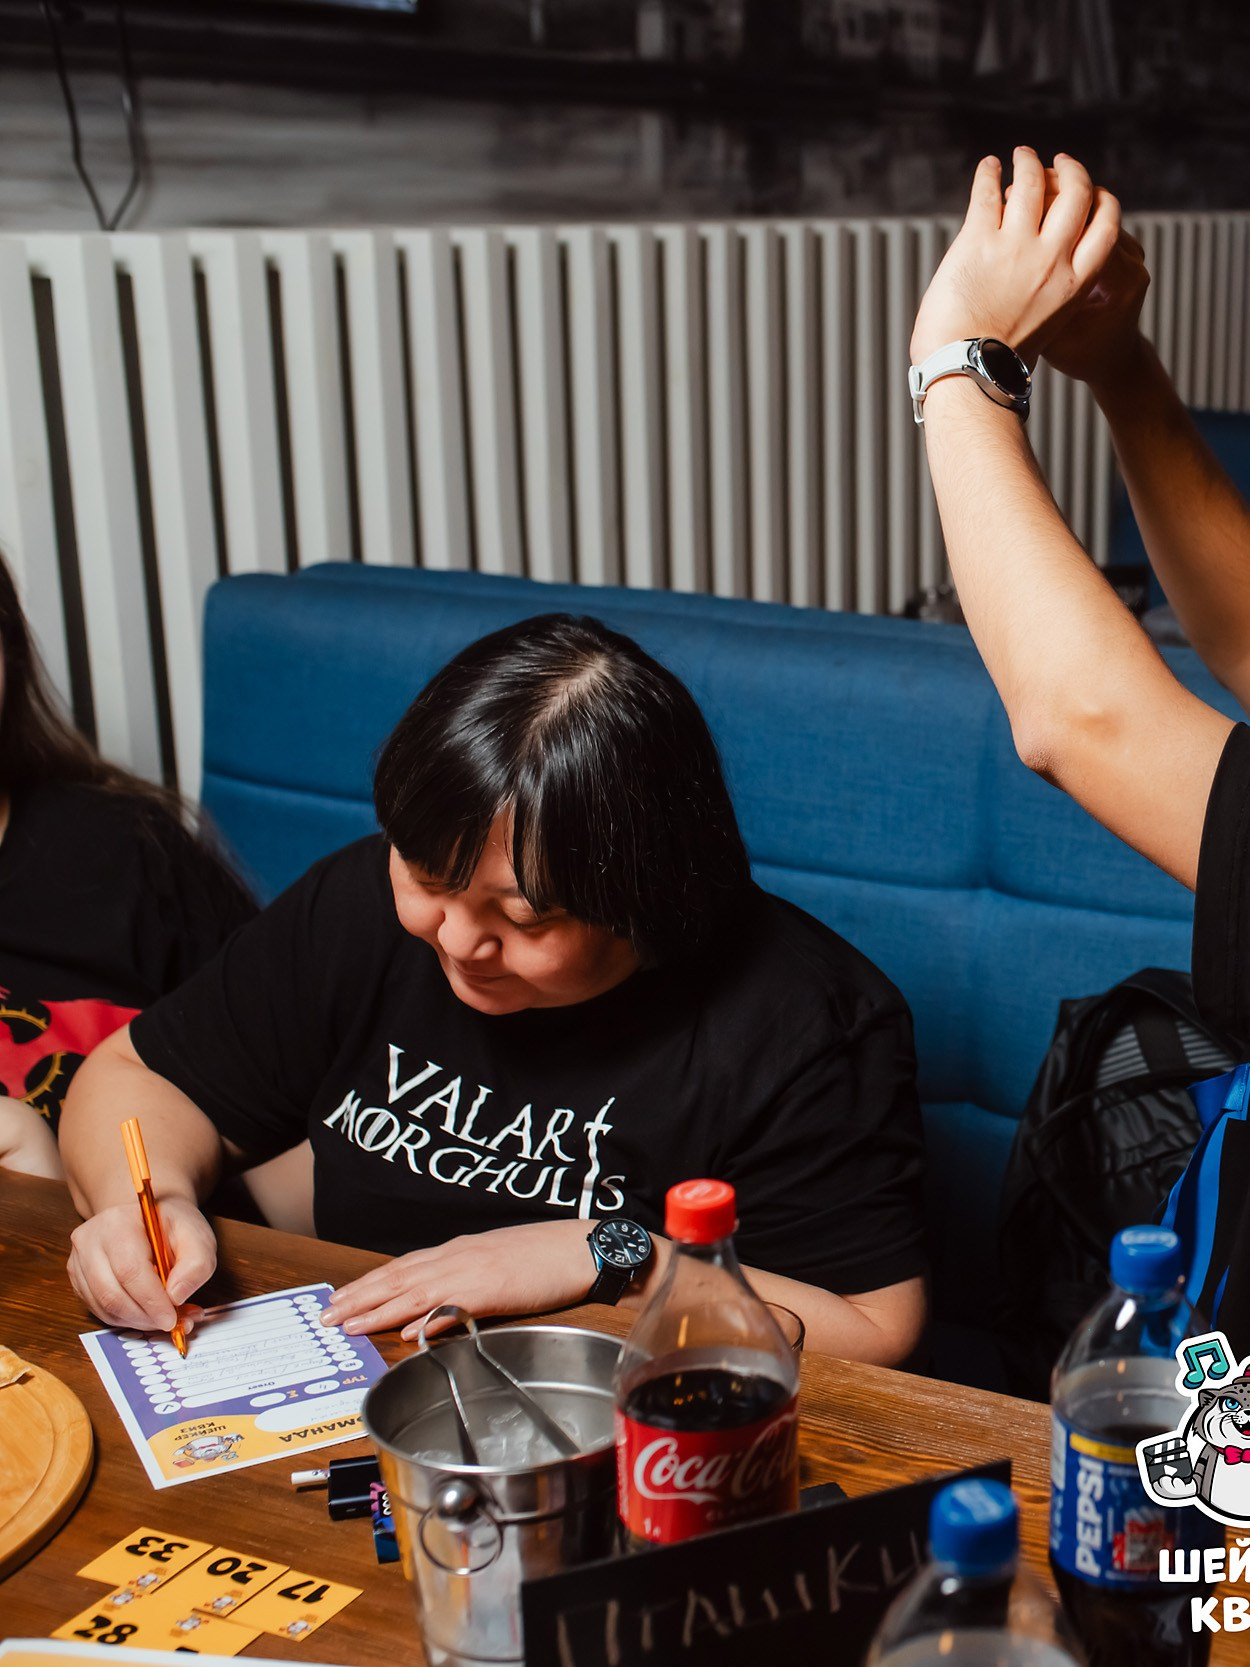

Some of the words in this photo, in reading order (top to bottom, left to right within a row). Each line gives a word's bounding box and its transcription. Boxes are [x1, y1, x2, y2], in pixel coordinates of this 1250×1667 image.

[388, 1043, 576, 1162] VALAR
[322, 1089, 626, 1220] MORGHULIS
[342, 1374, 368, 1386] ТУР
[174, 1424, 227, 1442] ШЕЙКЕР
[179, 1421, 216, 1434] КВИЗ
[1075, 1454, 1105, 1578] PEPSI
[125, 1536, 189, 1563] 33
[206, 1557, 268, 1585] 20
[277, 1580, 331, 1604] 17
[73, 1615, 139, 1645] 28
